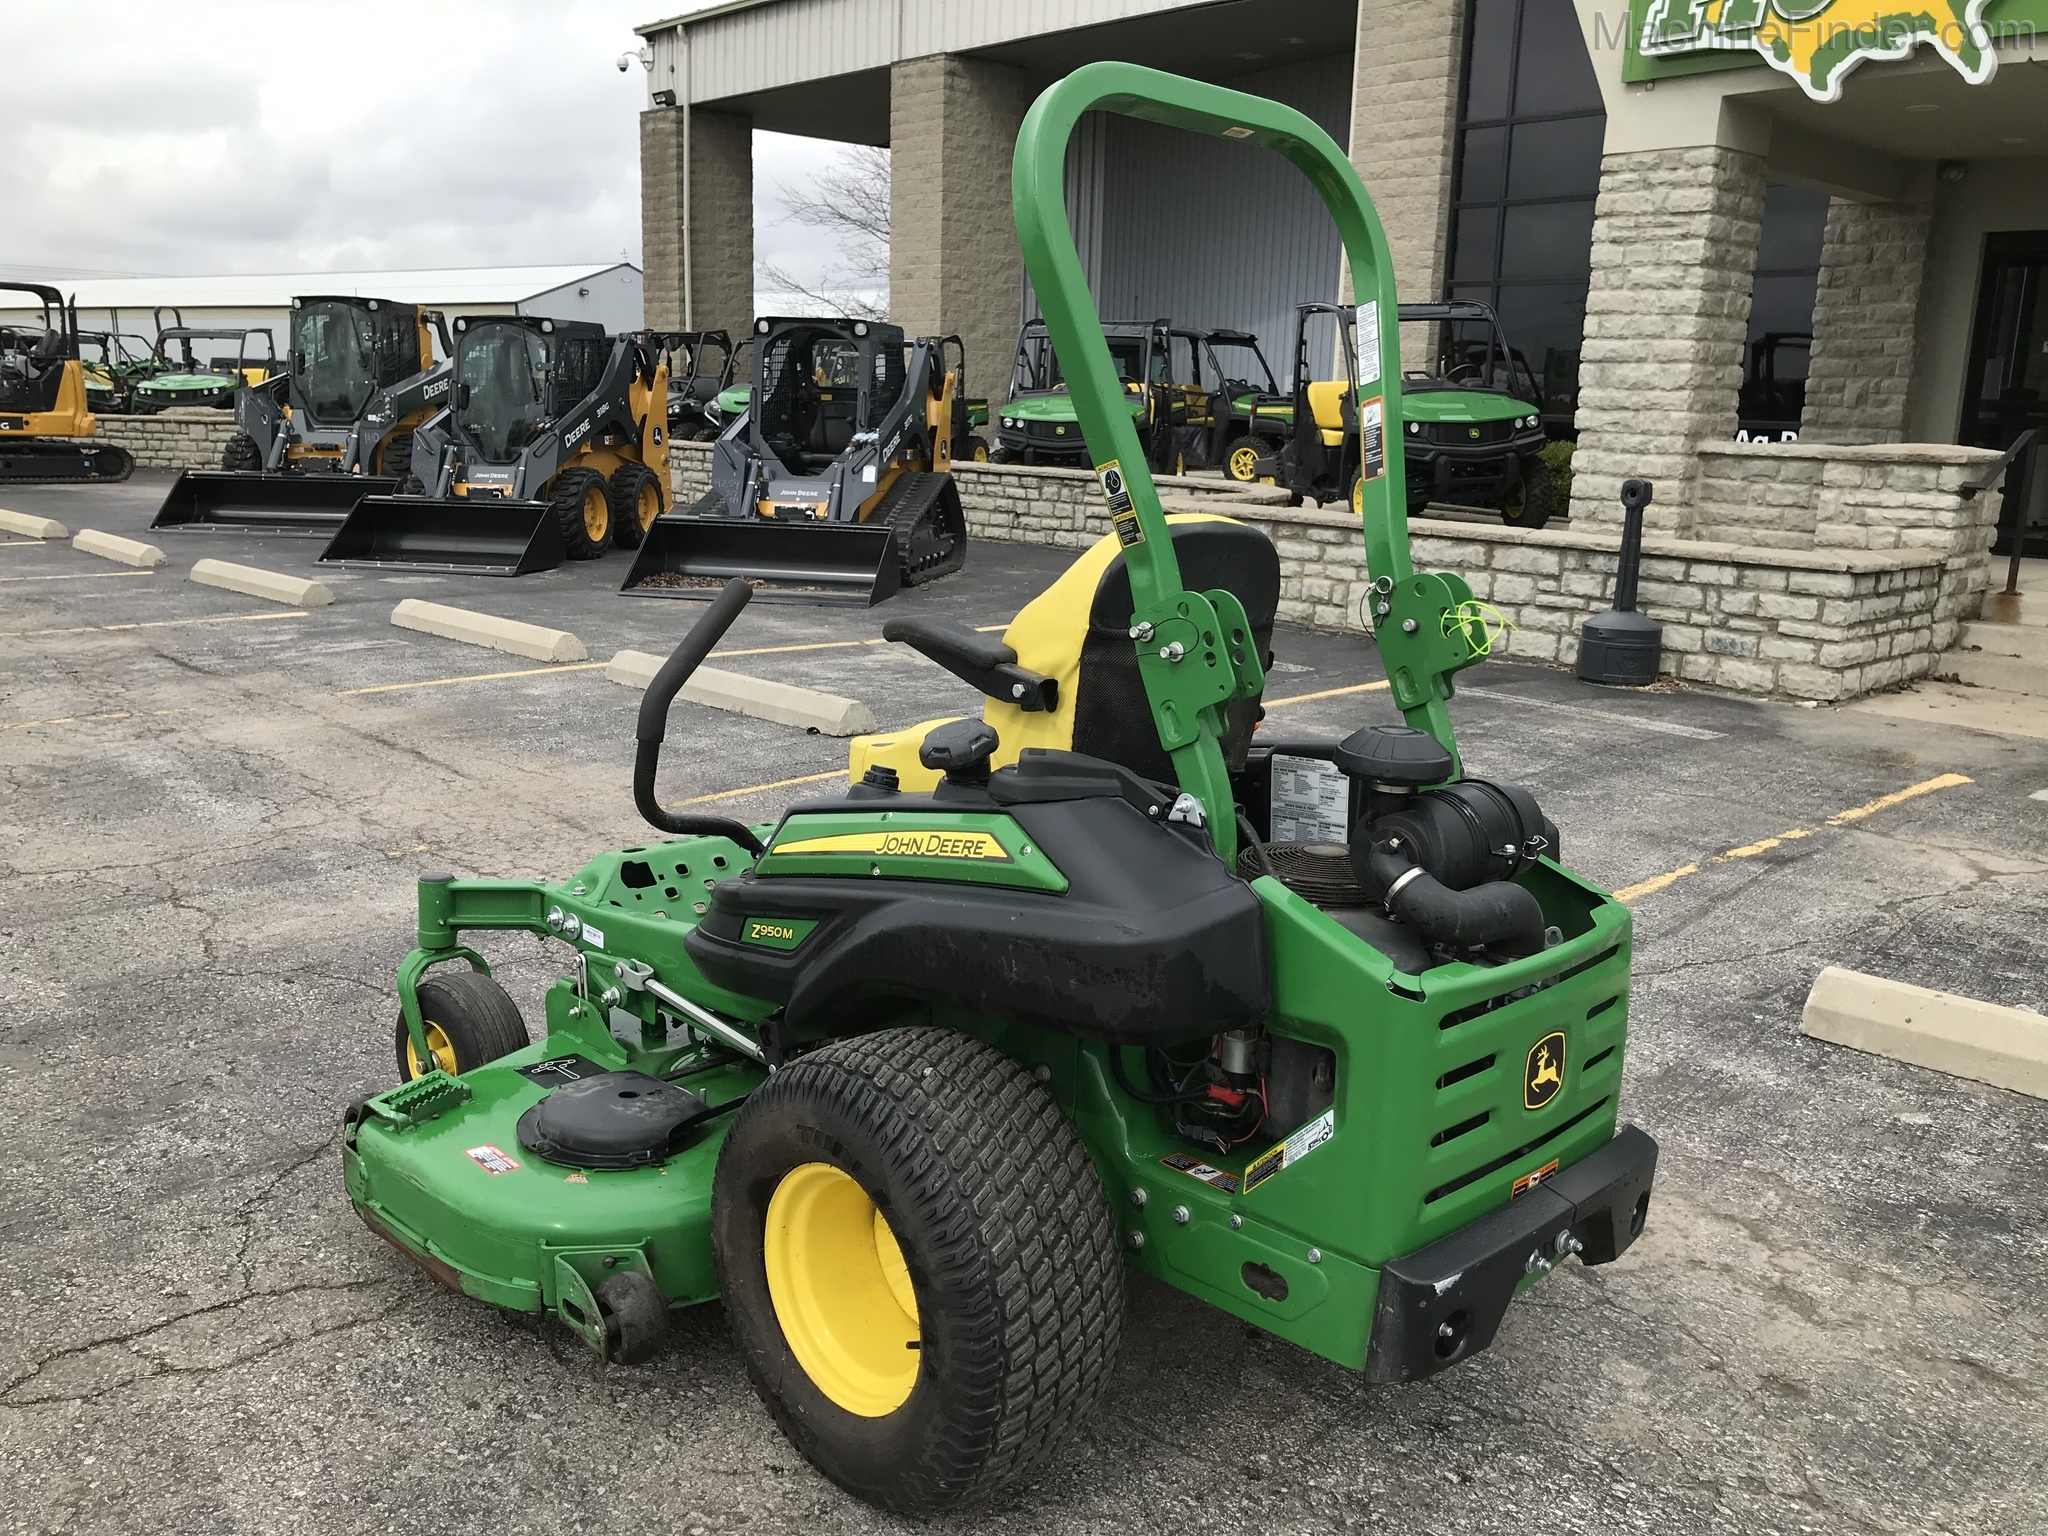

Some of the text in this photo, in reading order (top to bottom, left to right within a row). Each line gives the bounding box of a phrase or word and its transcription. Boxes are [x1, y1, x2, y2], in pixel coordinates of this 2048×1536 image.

[422, 378, 449, 400] DEERE
[564, 418, 591, 449] DEERE
[883, 430, 901, 464] DEERE
[876, 834, 987, 856] JOHN DEERE
[751, 923, 794, 940] Z950M
